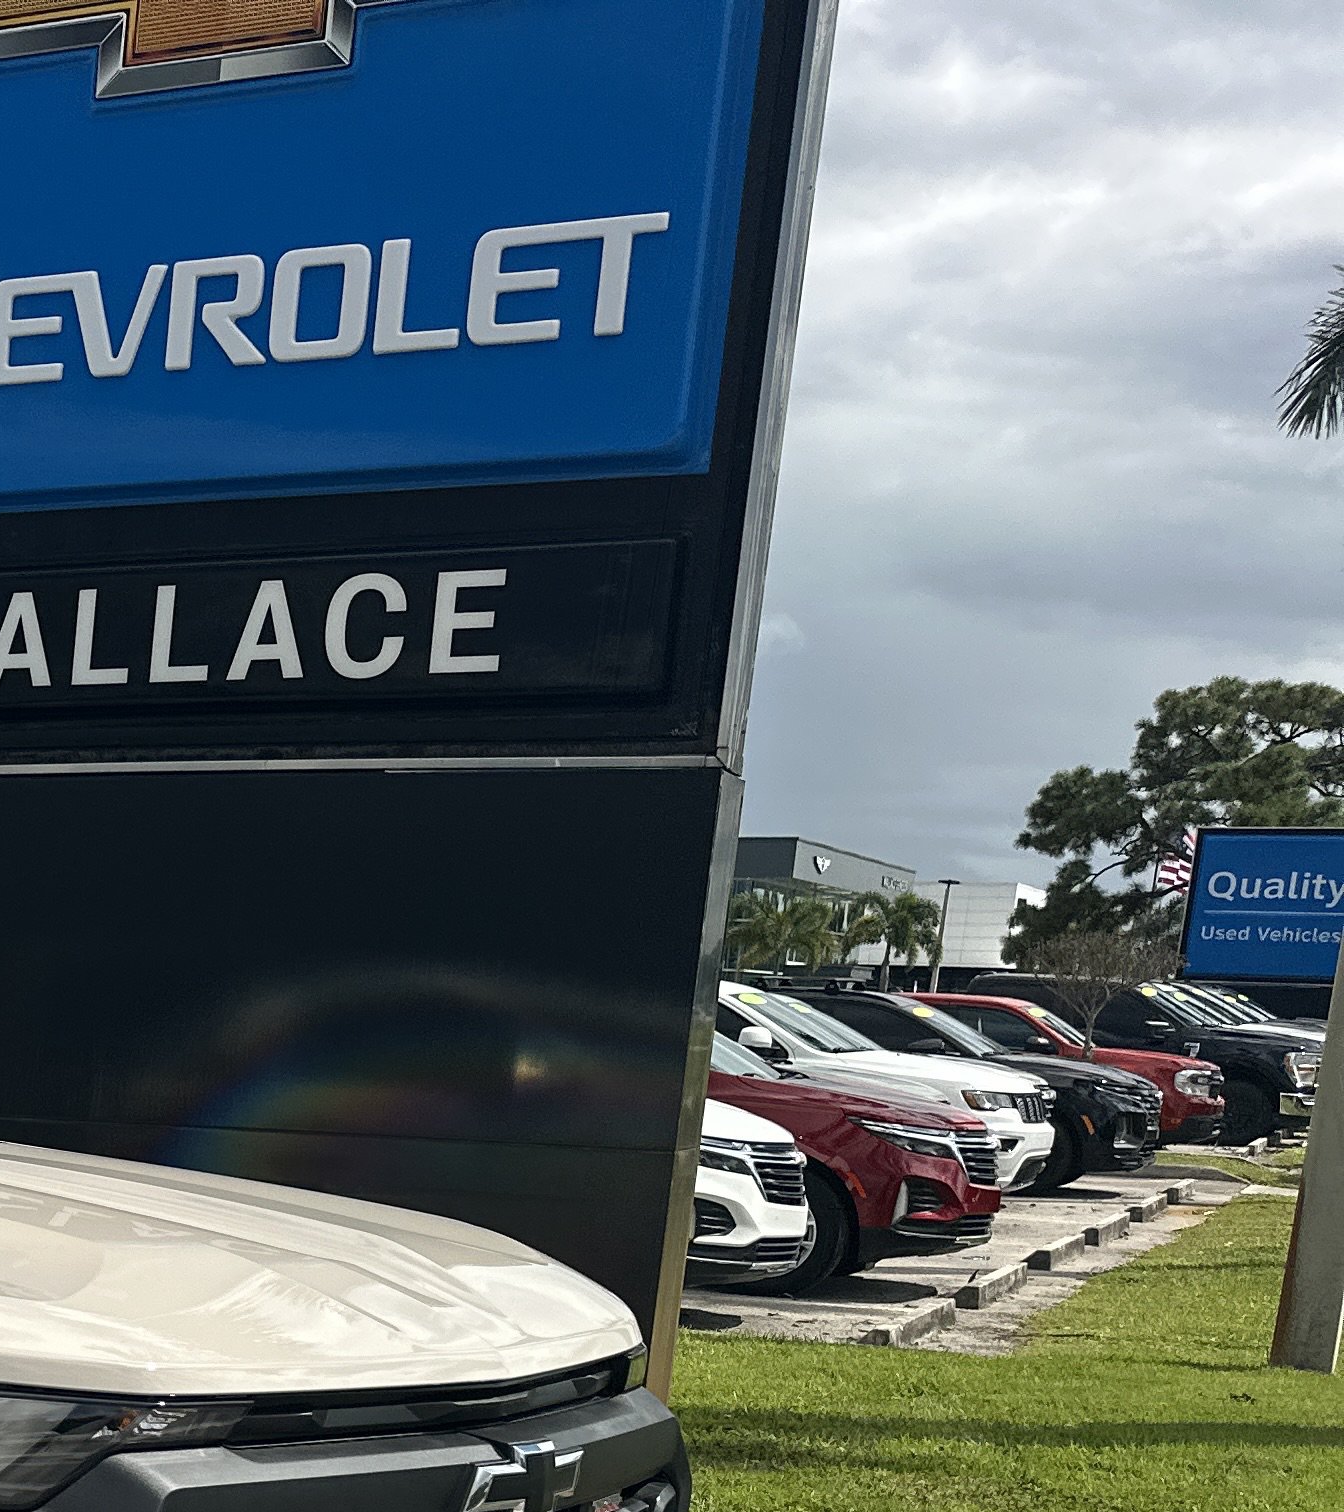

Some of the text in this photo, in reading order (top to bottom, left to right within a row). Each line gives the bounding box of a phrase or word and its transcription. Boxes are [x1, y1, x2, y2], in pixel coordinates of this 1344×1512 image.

[1207, 871, 1344, 908] Quality
[1201, 925, 1340, 943] Used Vehicles
